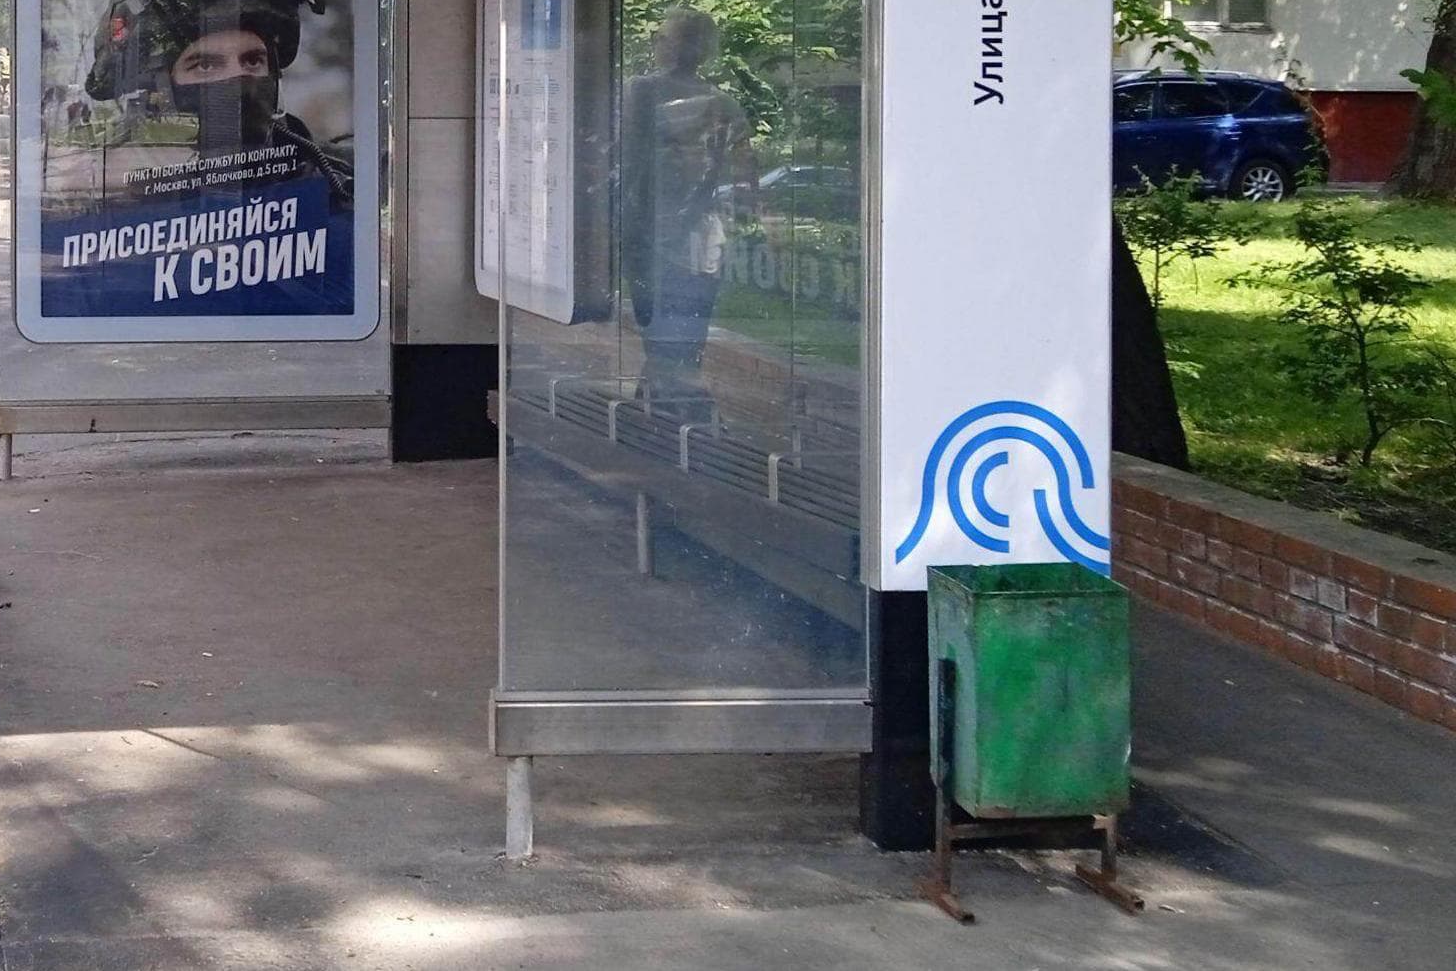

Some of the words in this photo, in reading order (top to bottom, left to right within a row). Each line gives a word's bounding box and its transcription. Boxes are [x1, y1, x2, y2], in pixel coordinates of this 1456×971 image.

[123, 168, 151, 185] ПУНКТ
[152, 162, 185, 179] ОТБОРА
[185, 161, 197, 173] НА
[198, 154, 233, 171] СЛУЖБУ
[234, 153, 247, 165] ПО
[248, 144, 299, 163] КОНТРАКТУ:
[63, 196, 298, 268] ПРИСОЕДИНЯЙСЯ
[153, 251, 182, 302] К
[190, 228, 327, 296] СВОИМ
